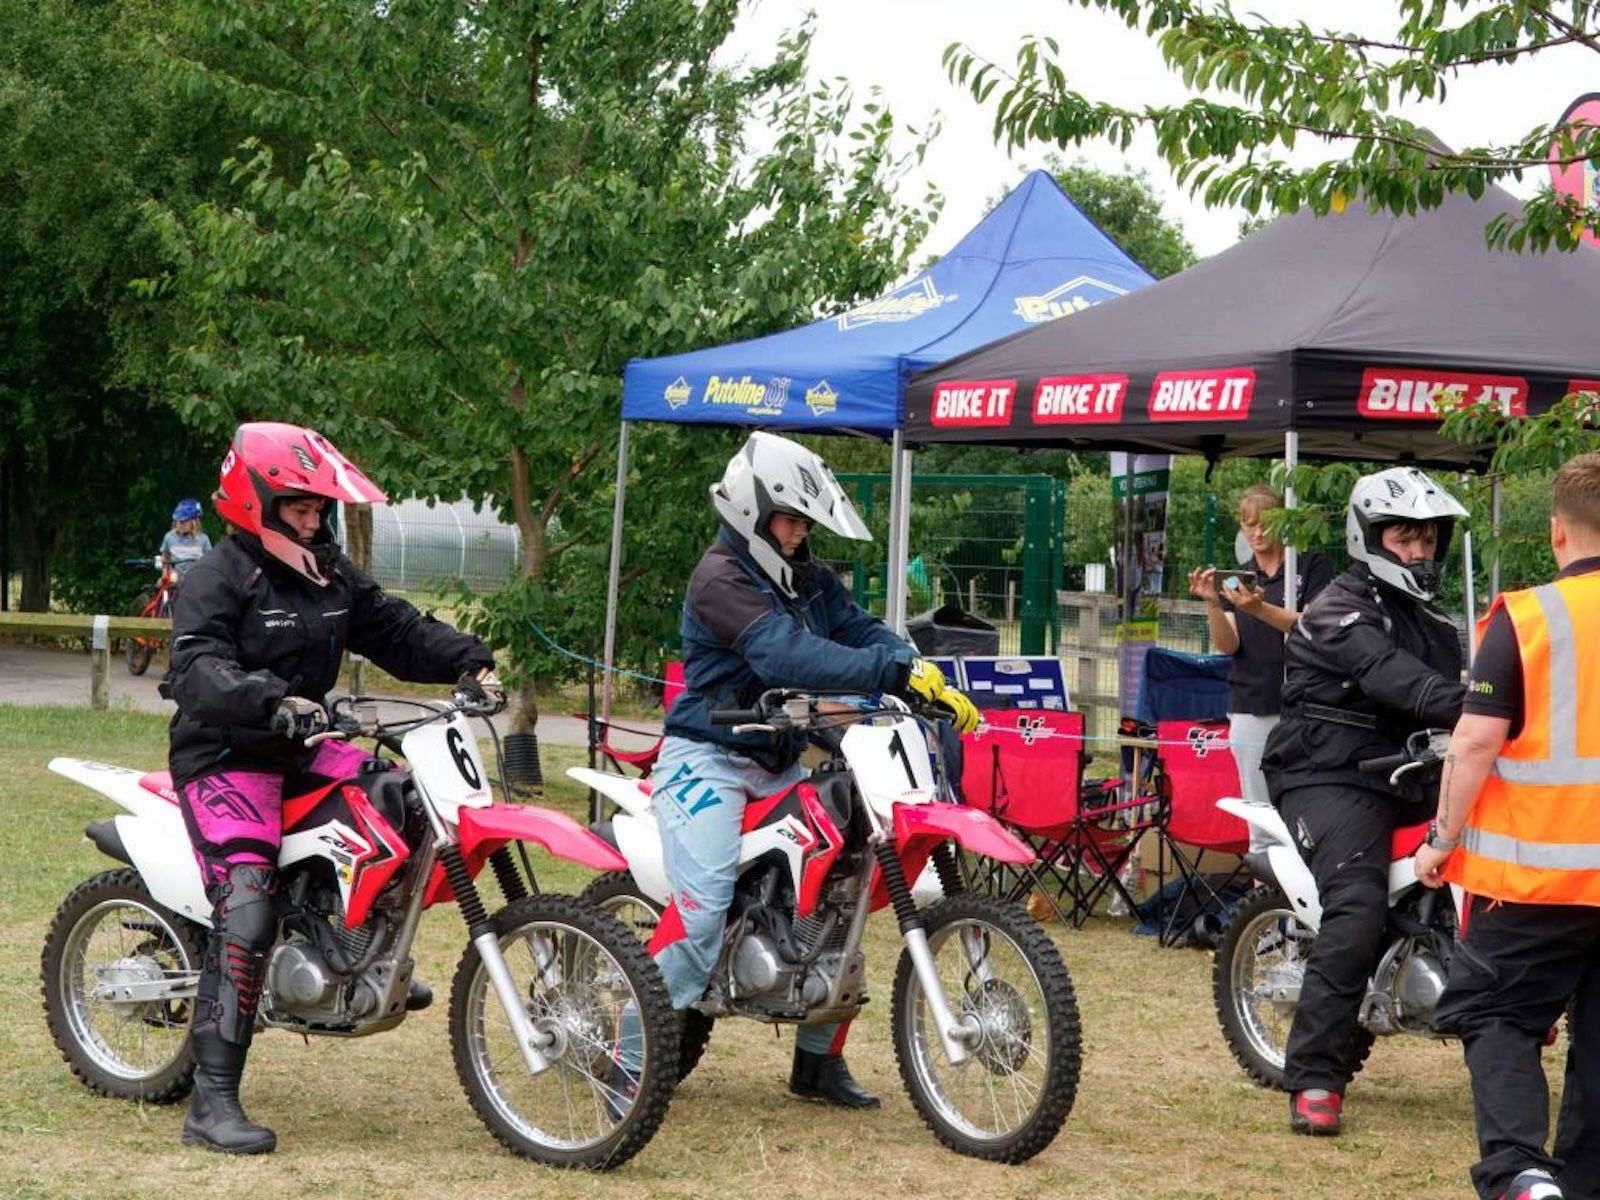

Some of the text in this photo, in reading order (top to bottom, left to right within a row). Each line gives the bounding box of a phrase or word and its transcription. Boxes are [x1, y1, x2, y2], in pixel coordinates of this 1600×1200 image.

[702, 375, 766, 405] Putoline
[936, 387, 1011, 418] BIKE IT
[1037, 383, 1121, 415] BIKE IT
[1152, 378, 1249, 412] BIKE IT
[446, 726, 482, 790] 6
[888, 729, 919, 789] 1
[665, 762, 723, 816] FLY
